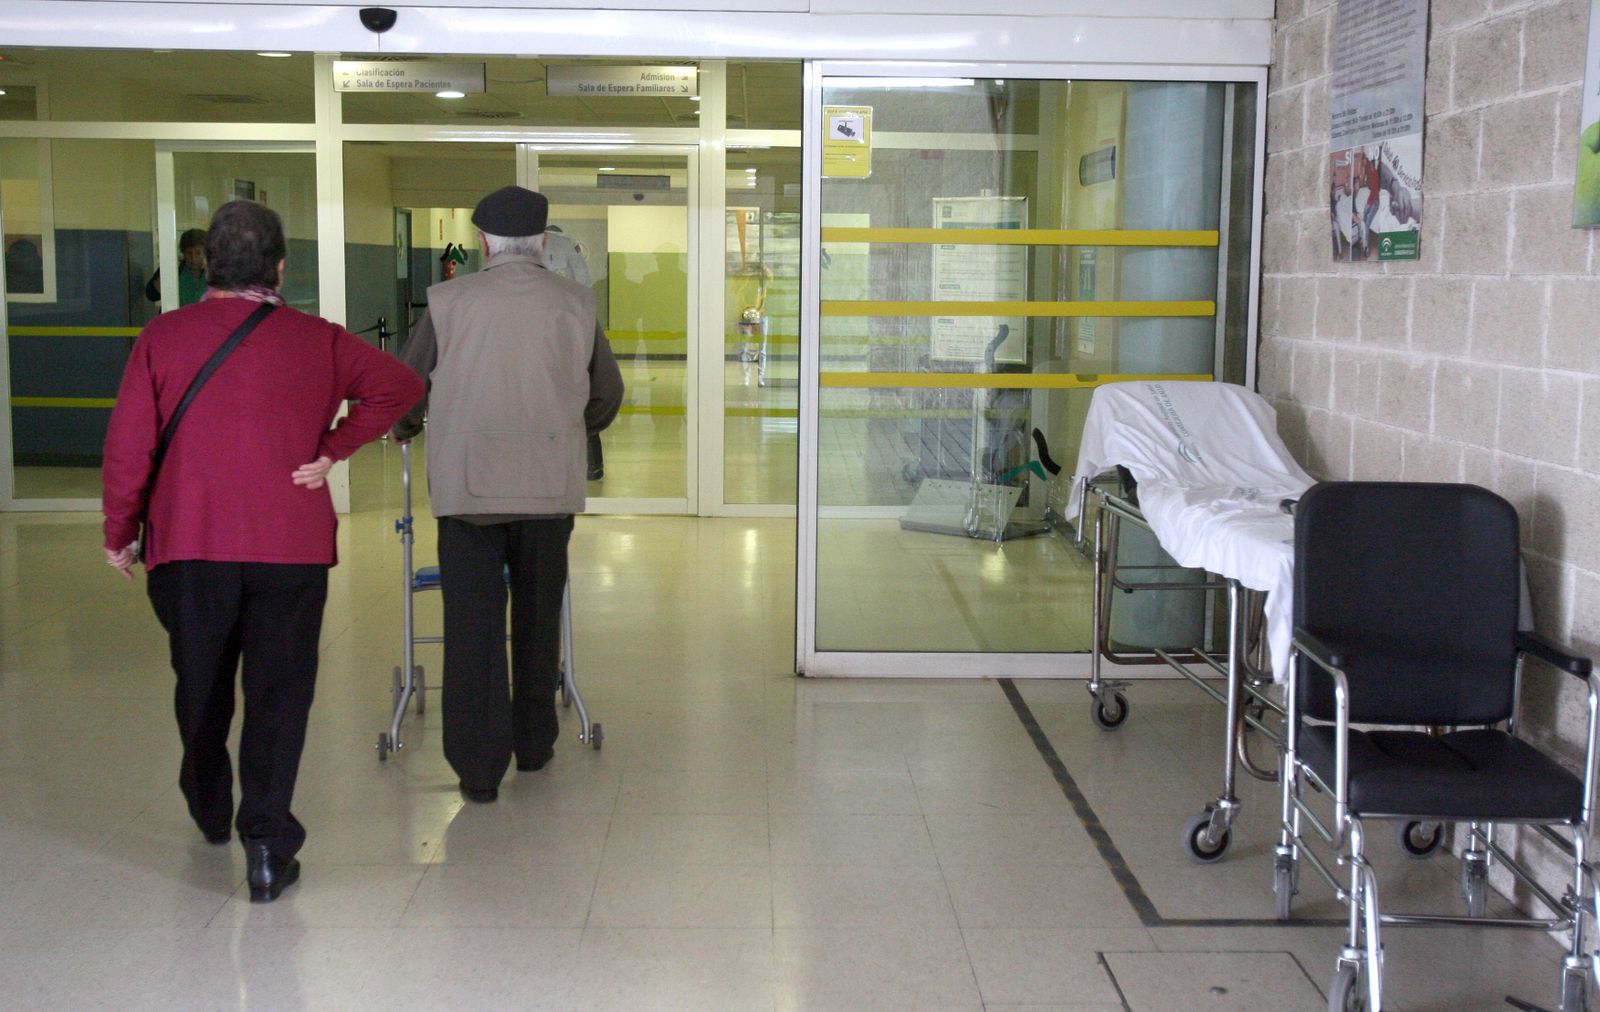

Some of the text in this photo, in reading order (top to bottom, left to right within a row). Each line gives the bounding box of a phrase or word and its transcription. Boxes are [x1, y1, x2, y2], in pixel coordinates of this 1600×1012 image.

[356, 79, 451, 91] Sala de Espera Pacientes
[578, 83, 675, 94] Sala de Espera Familiares
